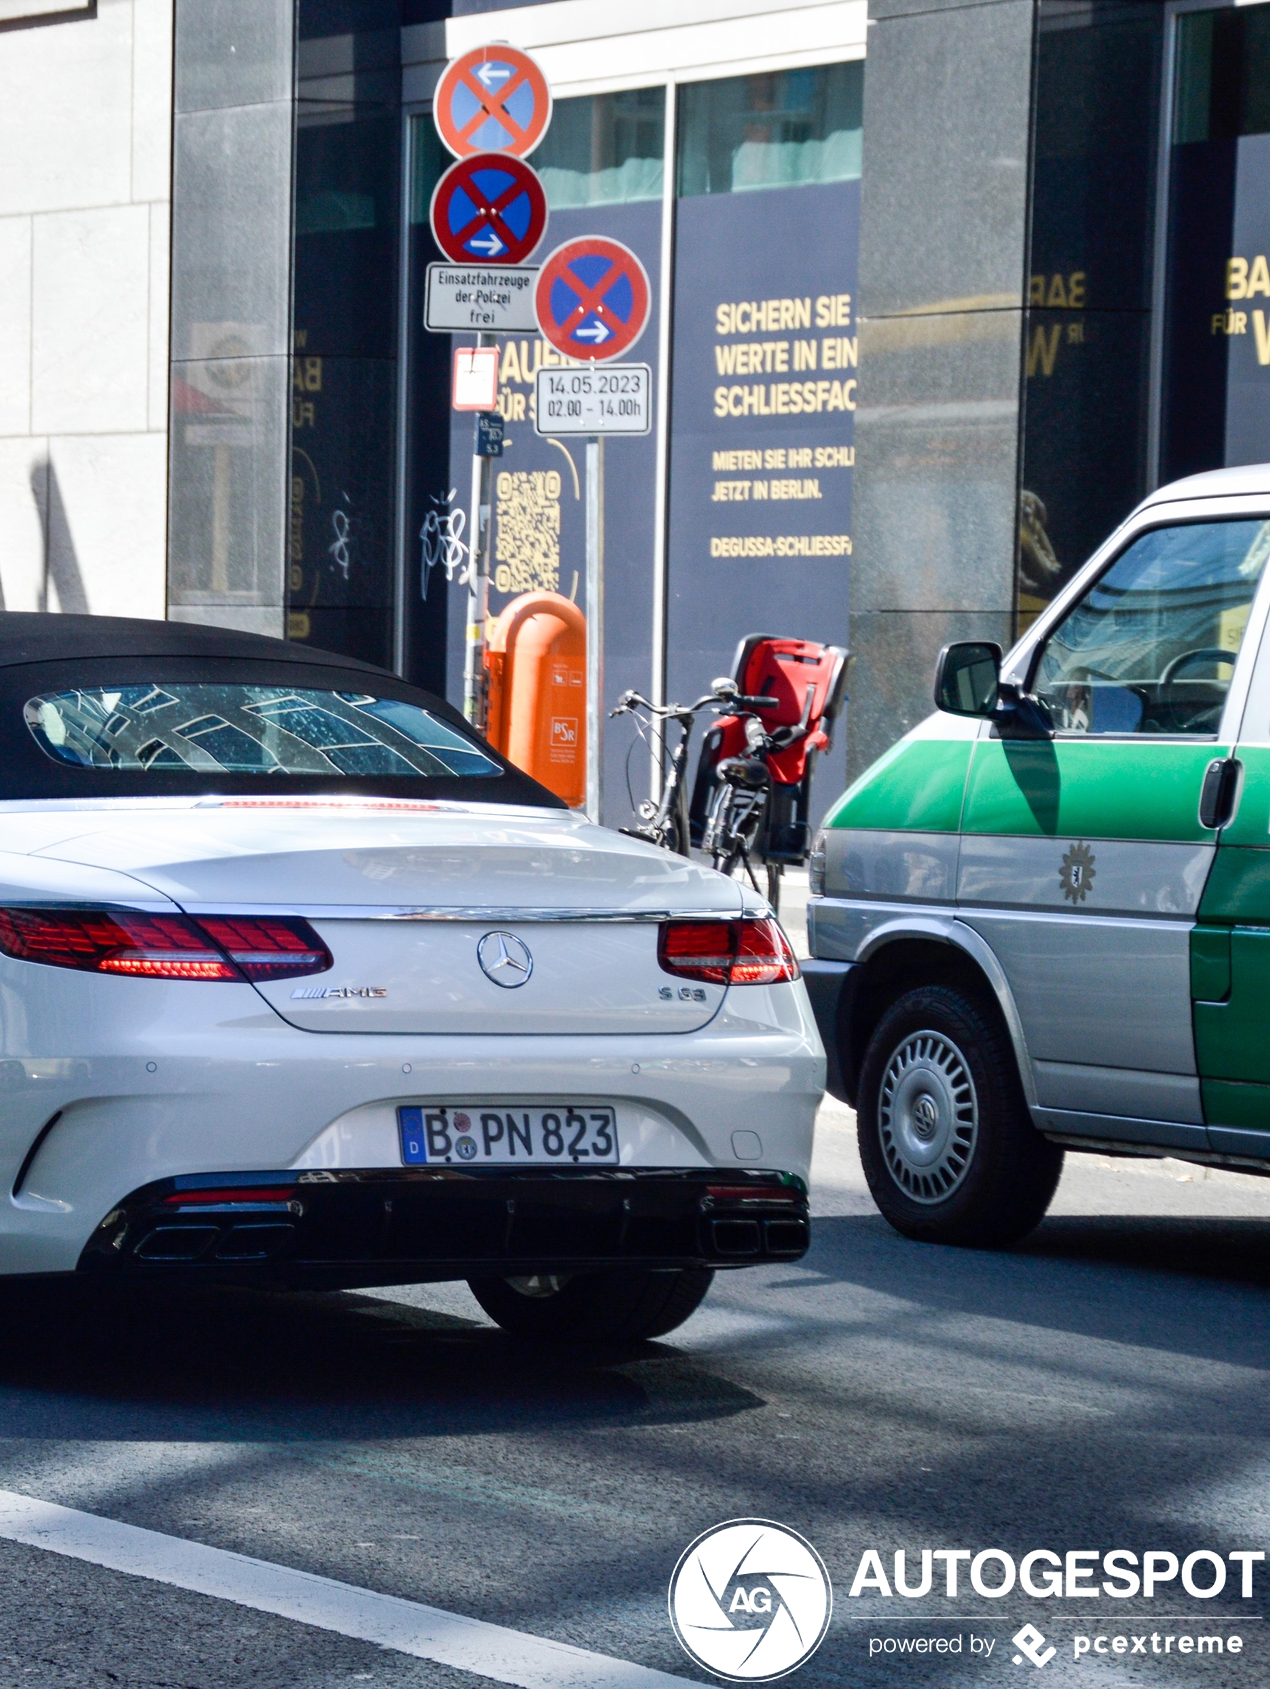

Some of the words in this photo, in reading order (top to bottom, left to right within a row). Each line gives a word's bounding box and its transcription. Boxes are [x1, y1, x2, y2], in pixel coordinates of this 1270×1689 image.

[438, 271, 530, 291] Einsatzfahrzeuge
[455, 290, 472, 303] der
[477, 290, 511, 304] Polizei
[470, 309, 496, 324] frei
[715, 298, 811, 335] SICHERN
[815, 294, 852, 328] SIE
[714, 341, 790, 376] WERTE
[793, 339, 818, 371] IN
[822, 337, 858, 370] EIN
[548, 376, 641, 395] 14.05.2023
[714, 378, 858, 418] SCHLIESSFAC
[548, 400, 581, 417] 02.00
[600, 399, 641, 417] 14.00h
[712, 450, 762, 471] MIETEN
[764, 449, 786, 469] SIE
[788, 448, 812, 468] IHR
[712, 480, 751, 502] JETZT
[753, 480, 768, 500] IN
[770, 479, 822, 500] BERLIN.
[555, 722, 575, 741] BSR
[324, 987, 387, 998] AMG
[658, 986, 673, 1000] S
[678, 987, 706, 1002] 63
[425, 1113, 452, 1156] B
[480, 1113, 533, 1156] PN
[541, 1113, 613, 1156] 823
[410, 1142, 419, 1154] D
